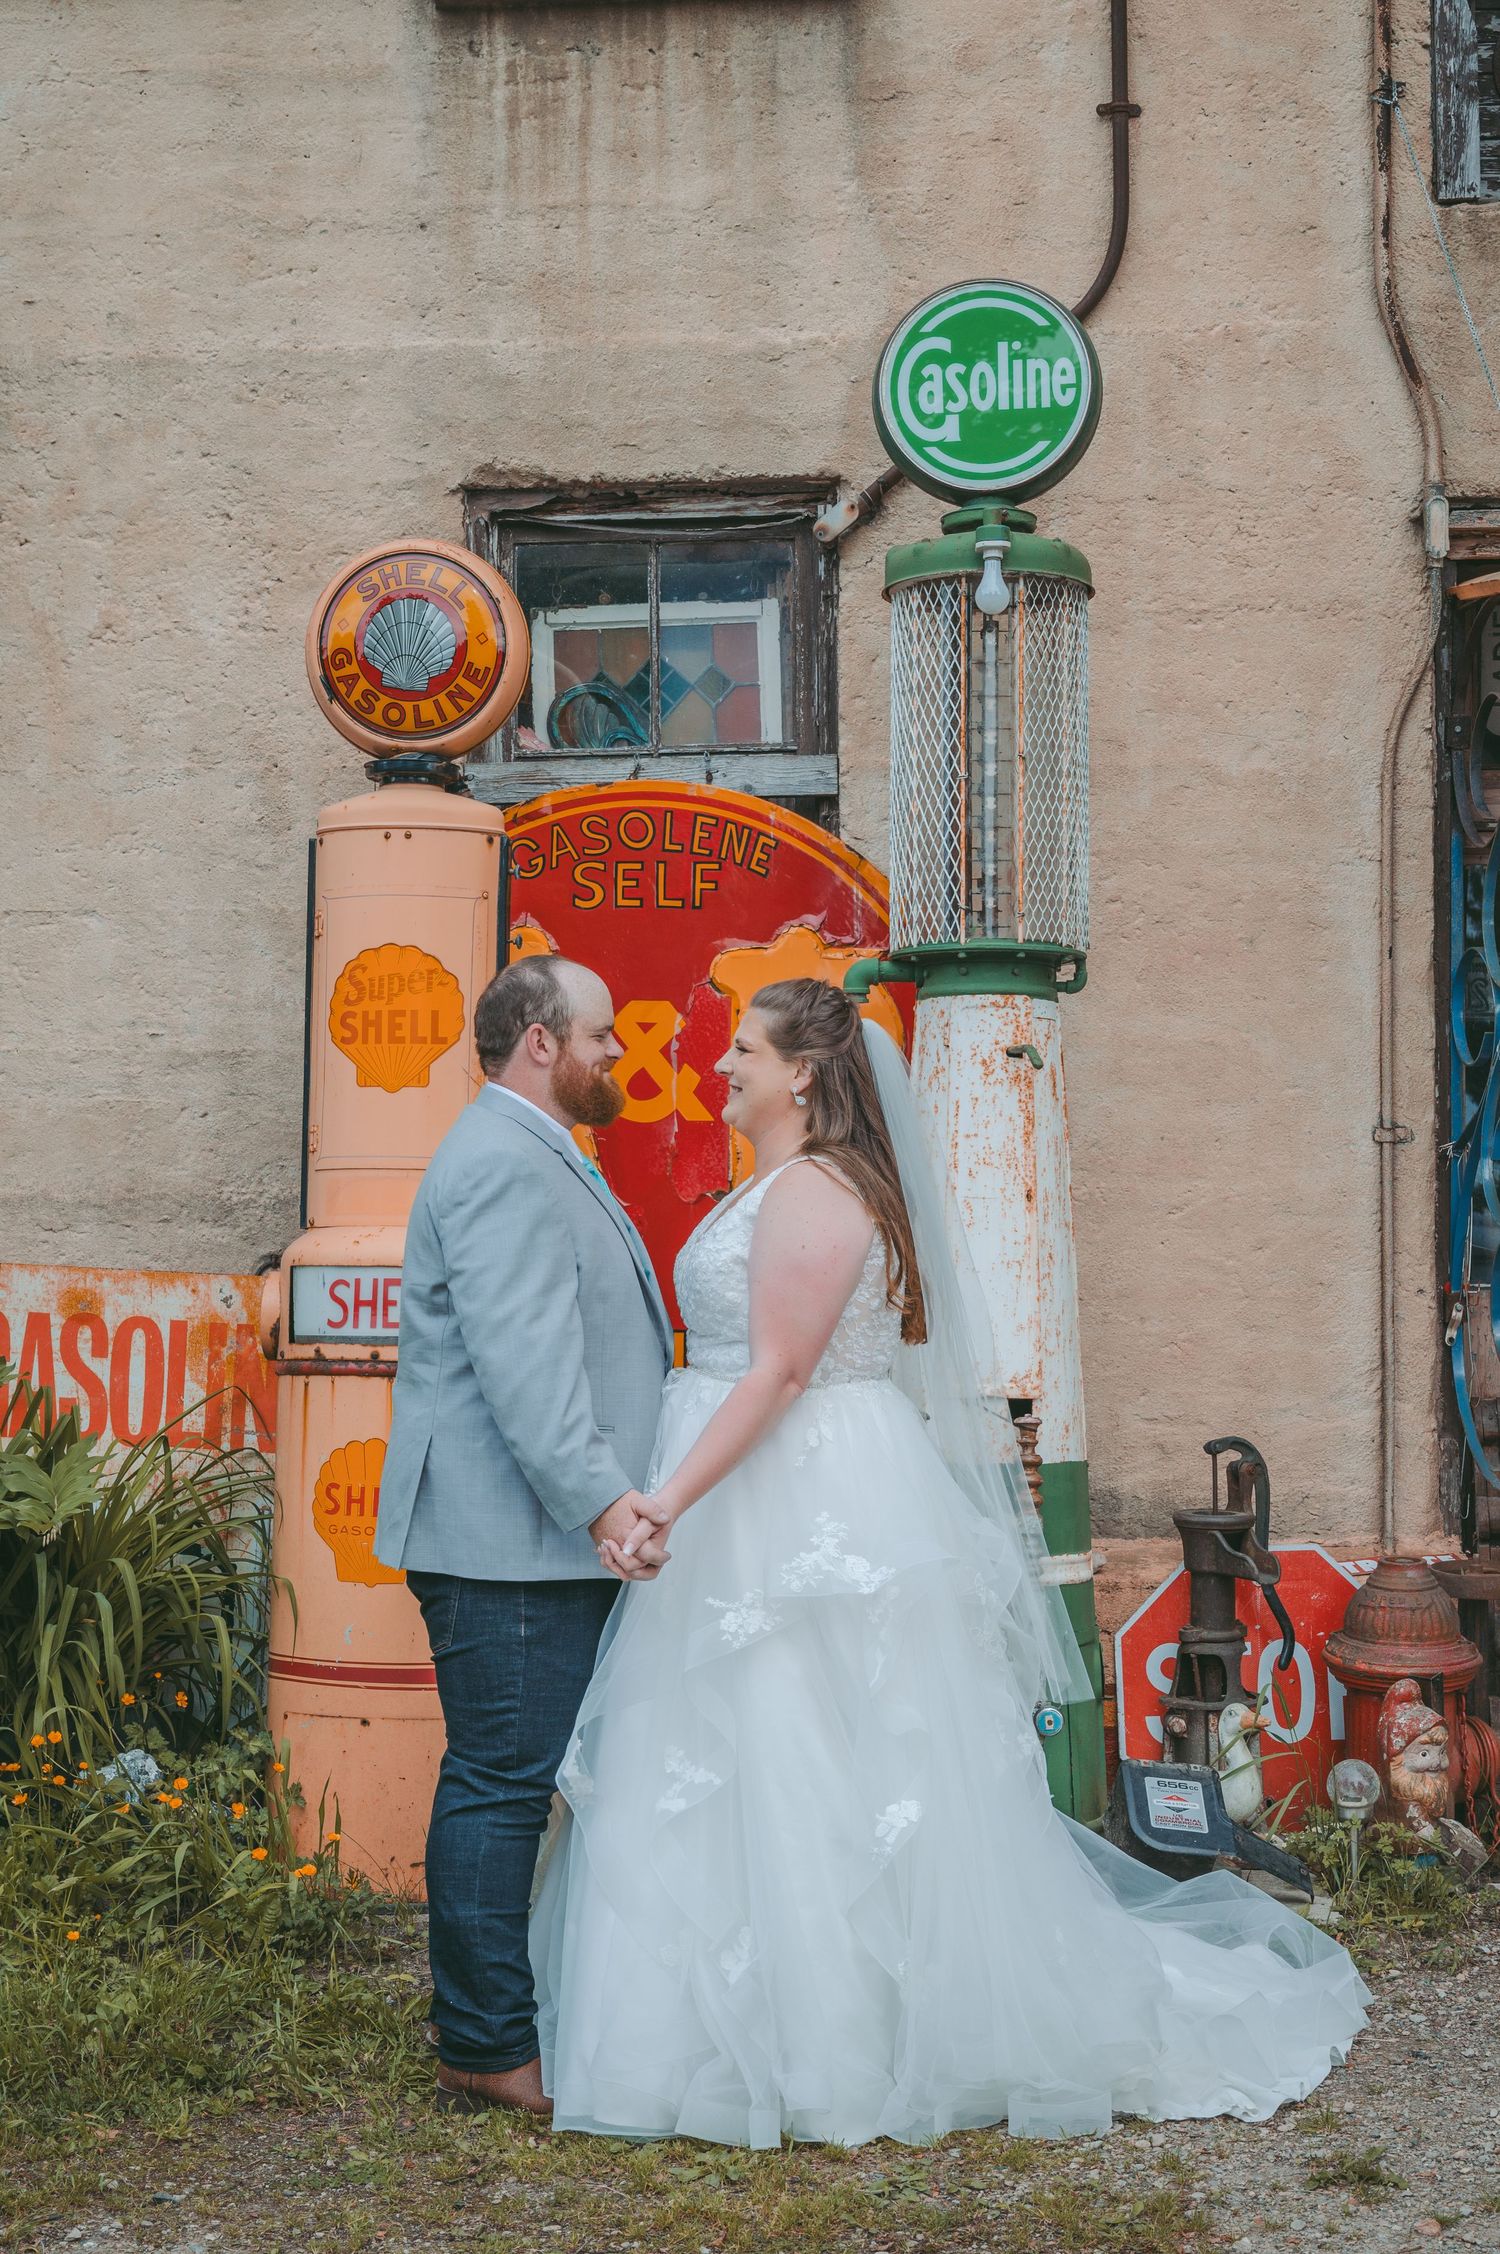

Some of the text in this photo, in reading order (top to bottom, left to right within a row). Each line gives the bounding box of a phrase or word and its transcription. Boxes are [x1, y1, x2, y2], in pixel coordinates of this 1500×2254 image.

[897, 336, 1077, 442] Gasoline
[356, 562, 468, 611] SHELL
[330, 647, 491, 729] GASOLINE
[511, 809, 779, 879] GASOLENE
[572, 860, 722, 910] SELF
[343, 963, 449, 1007] Super
[340, 1009, 448, 1045] SHELL
[326, 1277, 402, 1329] SHE
[0, 1311, 277, 1454] ASOLIN
